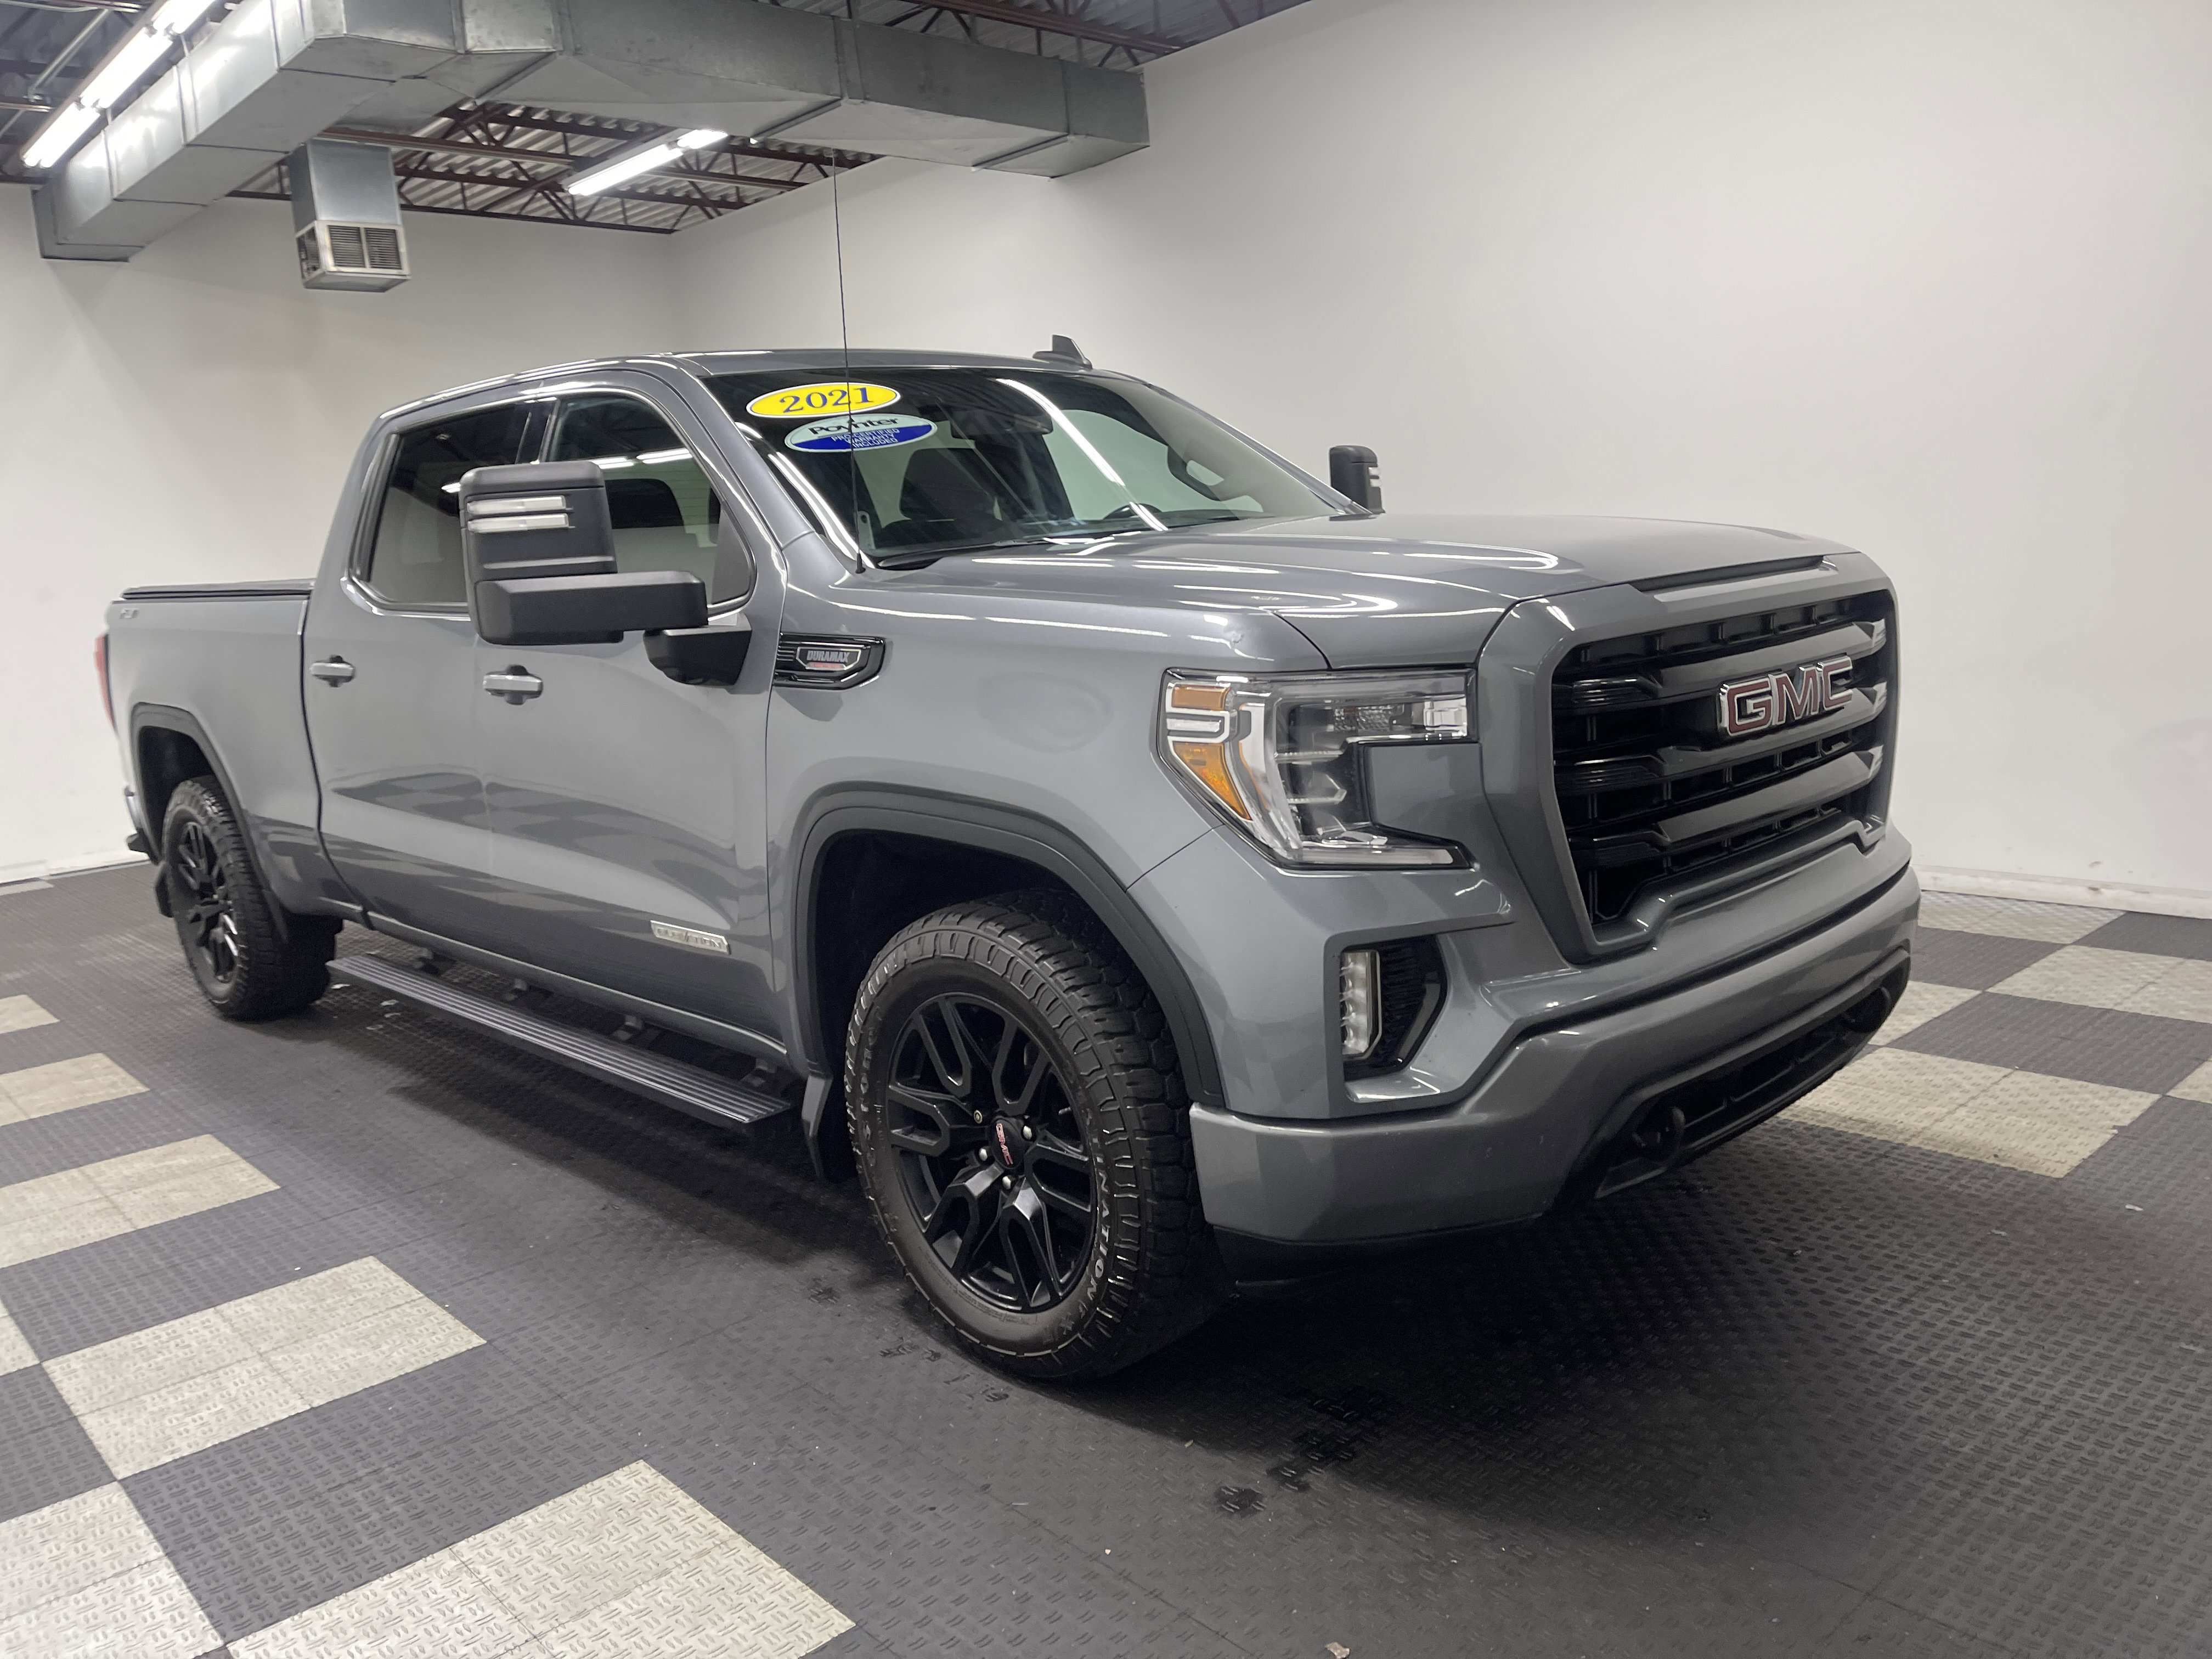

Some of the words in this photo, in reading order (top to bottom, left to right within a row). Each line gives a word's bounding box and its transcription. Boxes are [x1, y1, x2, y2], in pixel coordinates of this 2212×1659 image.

[780, 387, 874, 413] 2021
[806, 650, 850, 663] DURAMAX
[1719, 656, 1853, 736] GMC
[996, 1123, 1013, 1165] GMC
